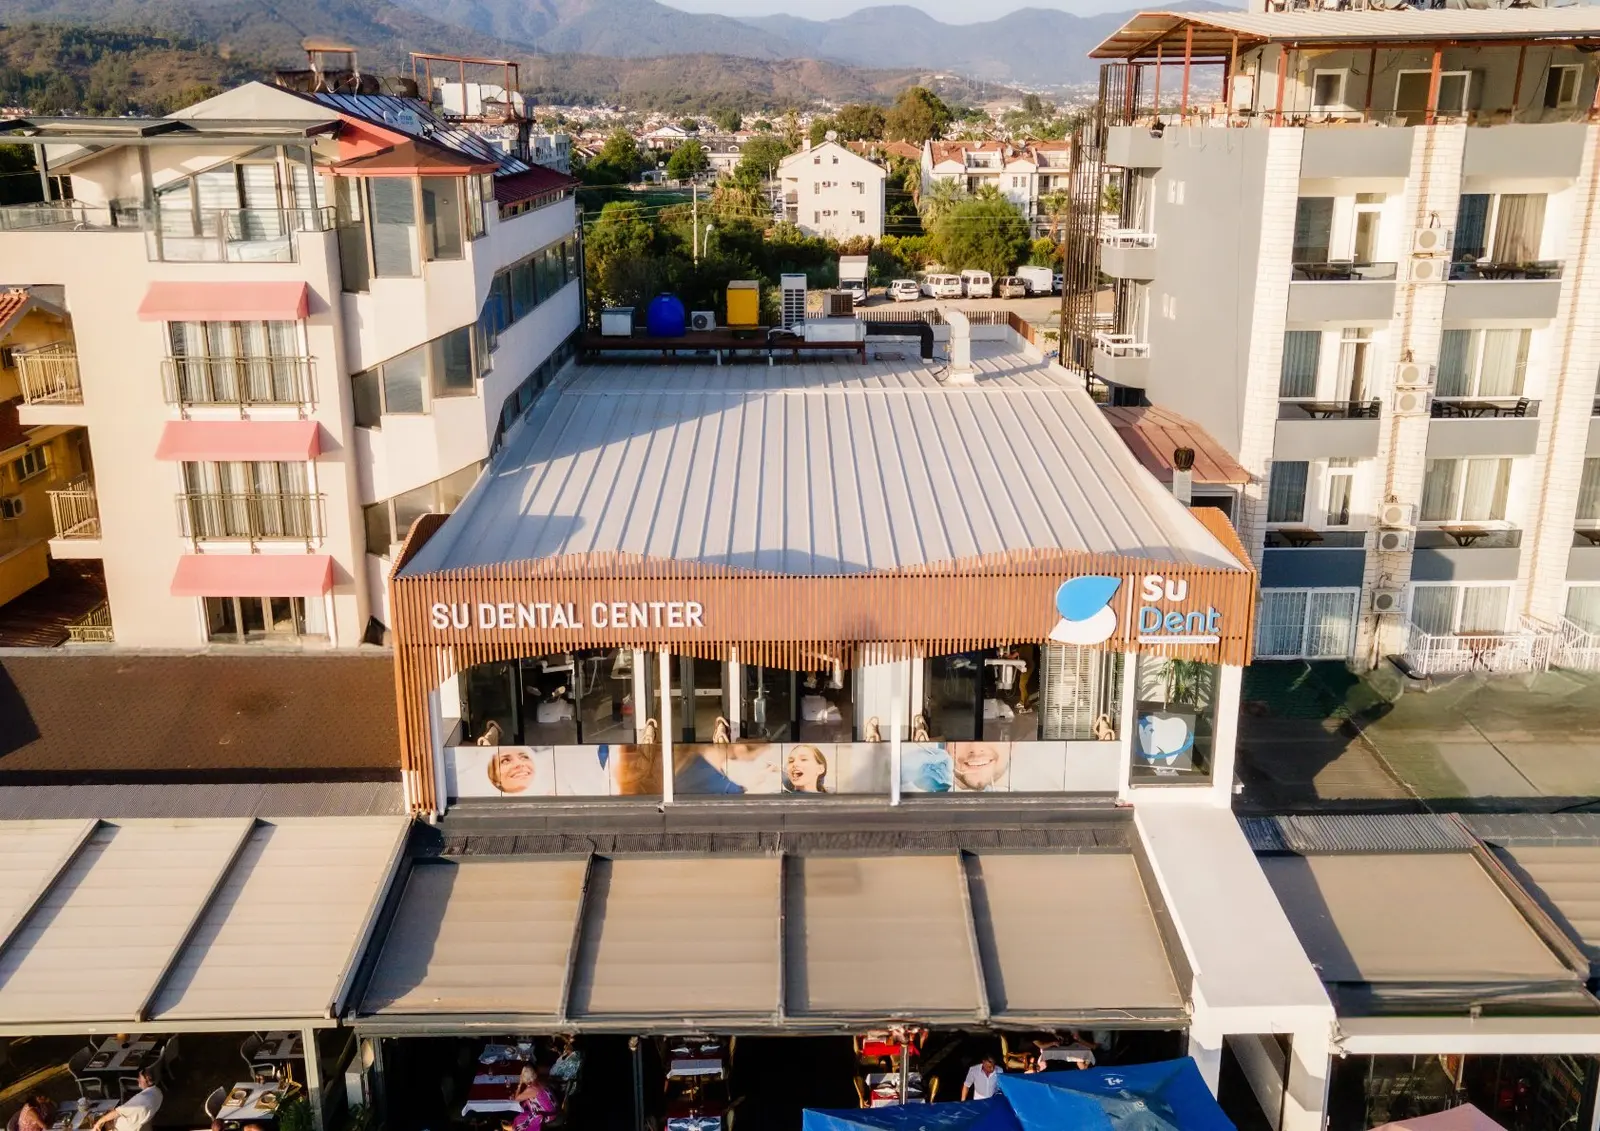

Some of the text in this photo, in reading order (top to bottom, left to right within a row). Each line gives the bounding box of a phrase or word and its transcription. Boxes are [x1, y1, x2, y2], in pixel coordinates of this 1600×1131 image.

[1142, 575, 1187, 602] Su
[432, 601, 704, 629] SU DENTAL CENTER
[1140, 607, 1221, 634] Dent
